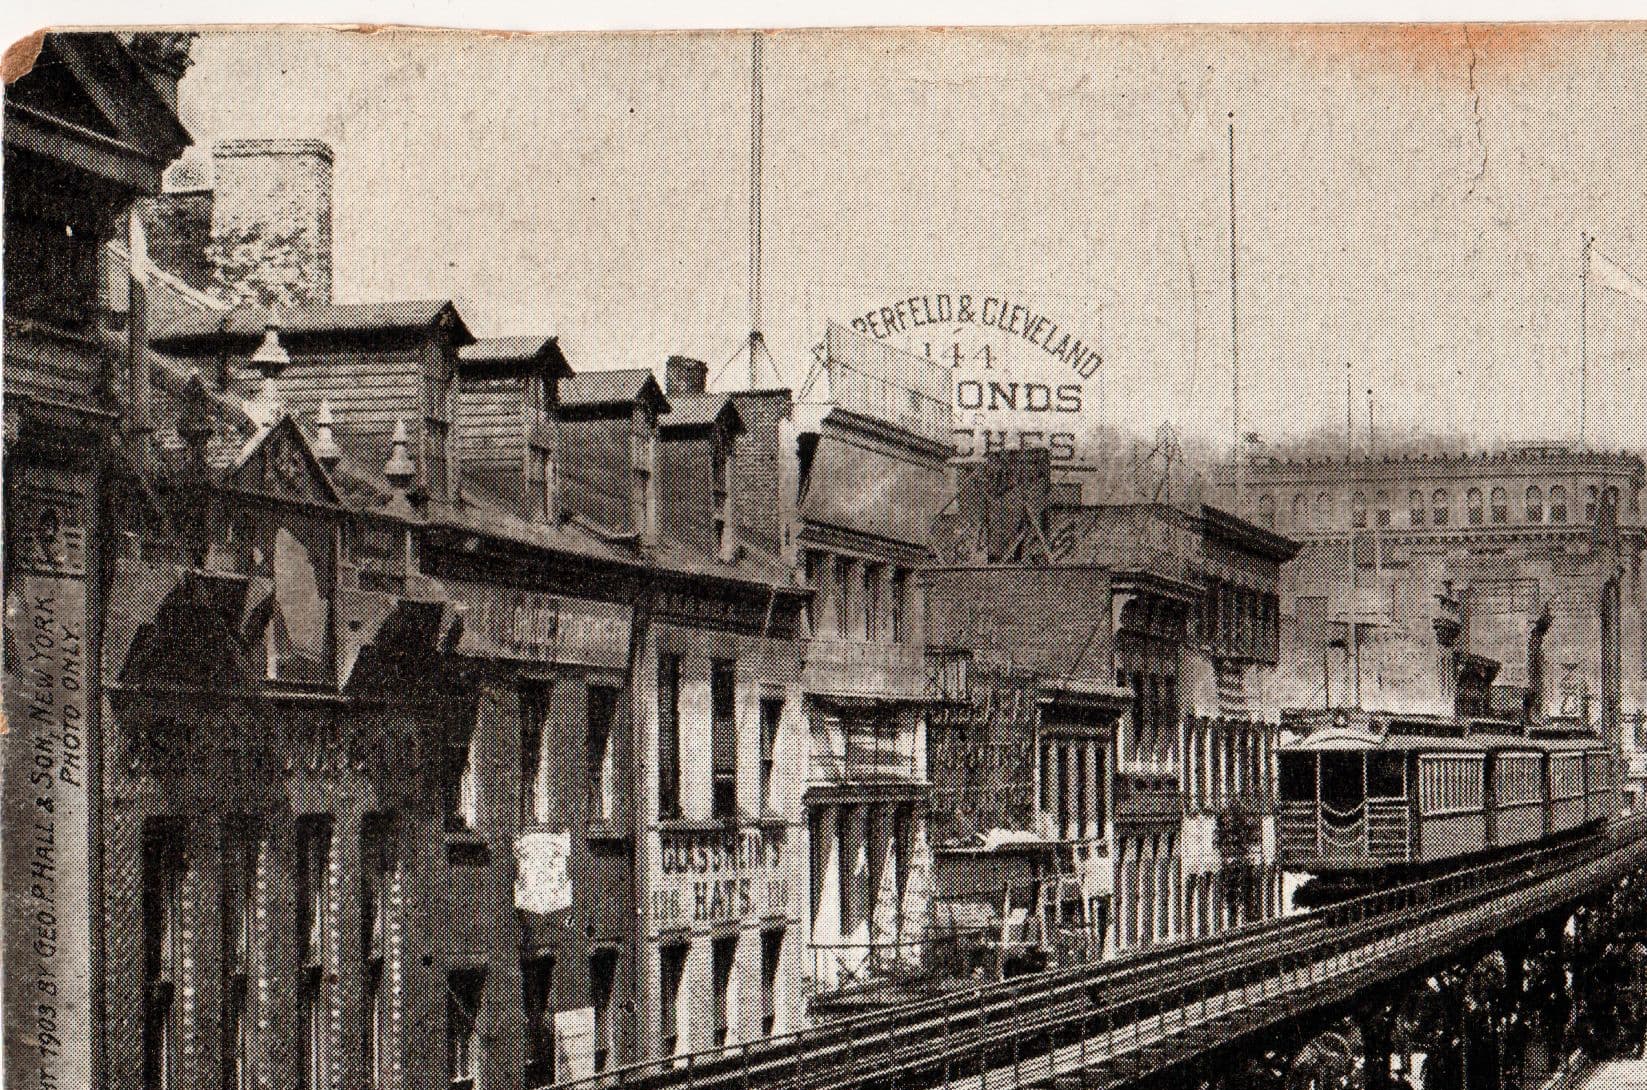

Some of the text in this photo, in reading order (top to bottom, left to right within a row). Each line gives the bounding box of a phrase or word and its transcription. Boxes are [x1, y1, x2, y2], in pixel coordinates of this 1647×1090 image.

[957, 294, 976, 323] &
[981, 296, 1102, 380] CLEVELAND
[957, 380, 1083, 414] ONDS
